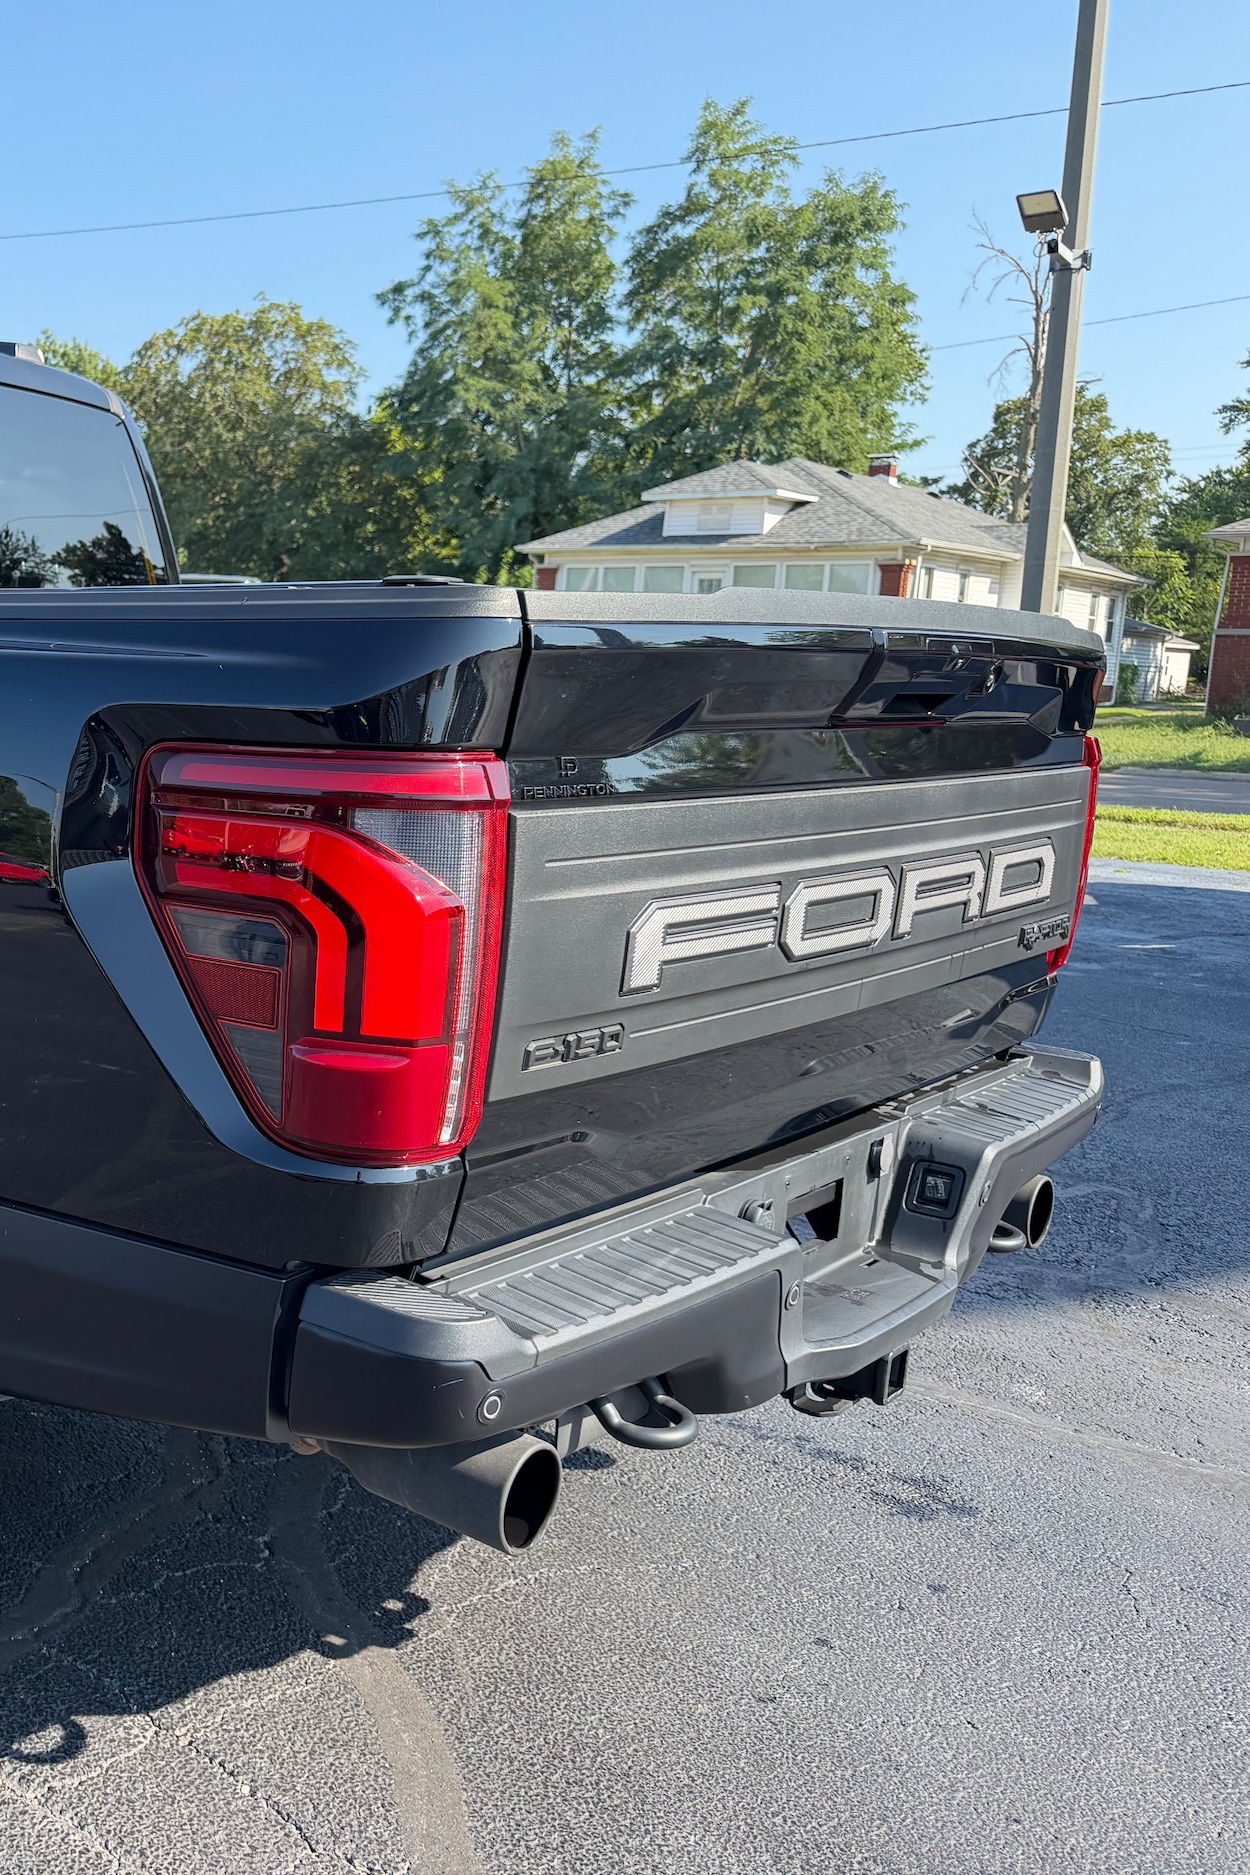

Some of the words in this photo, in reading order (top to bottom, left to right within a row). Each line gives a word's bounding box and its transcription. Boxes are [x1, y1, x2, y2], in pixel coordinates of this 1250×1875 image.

[521, 783, 616, 800] PENNINGTON
[618, 836, 1056, 997] FORD
[521, 1022, 625, 1073] F-150
